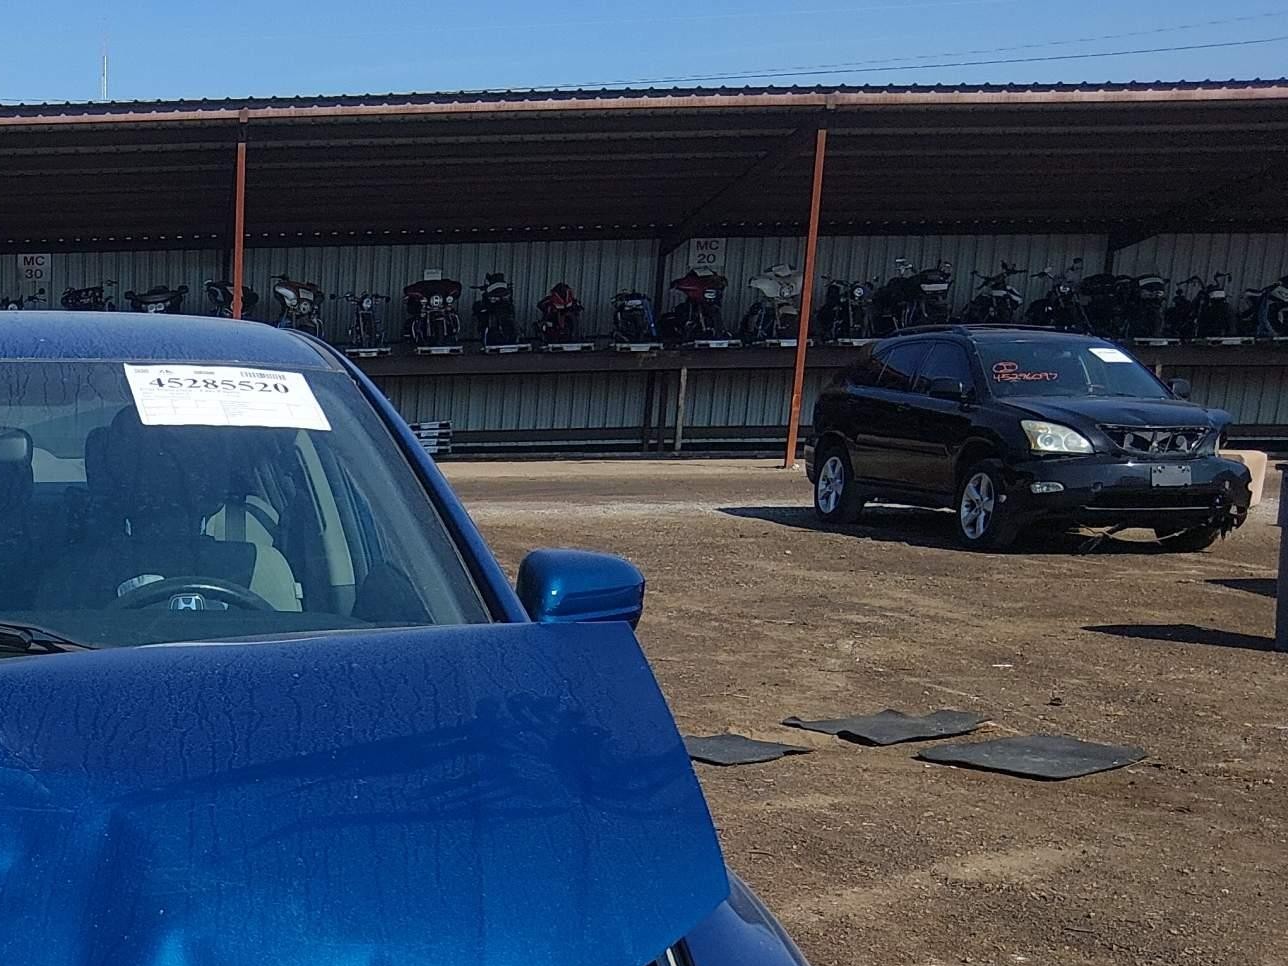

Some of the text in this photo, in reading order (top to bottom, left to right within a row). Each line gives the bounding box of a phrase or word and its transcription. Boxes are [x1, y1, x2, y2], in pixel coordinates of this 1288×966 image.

[696, 240, 720, 251] MC
[23, 255, 46, 266] MC
[696, 253, 716, 264] 20
[24, 268, 44, 279] 30
[148, 377, 290, 395] 45285520
